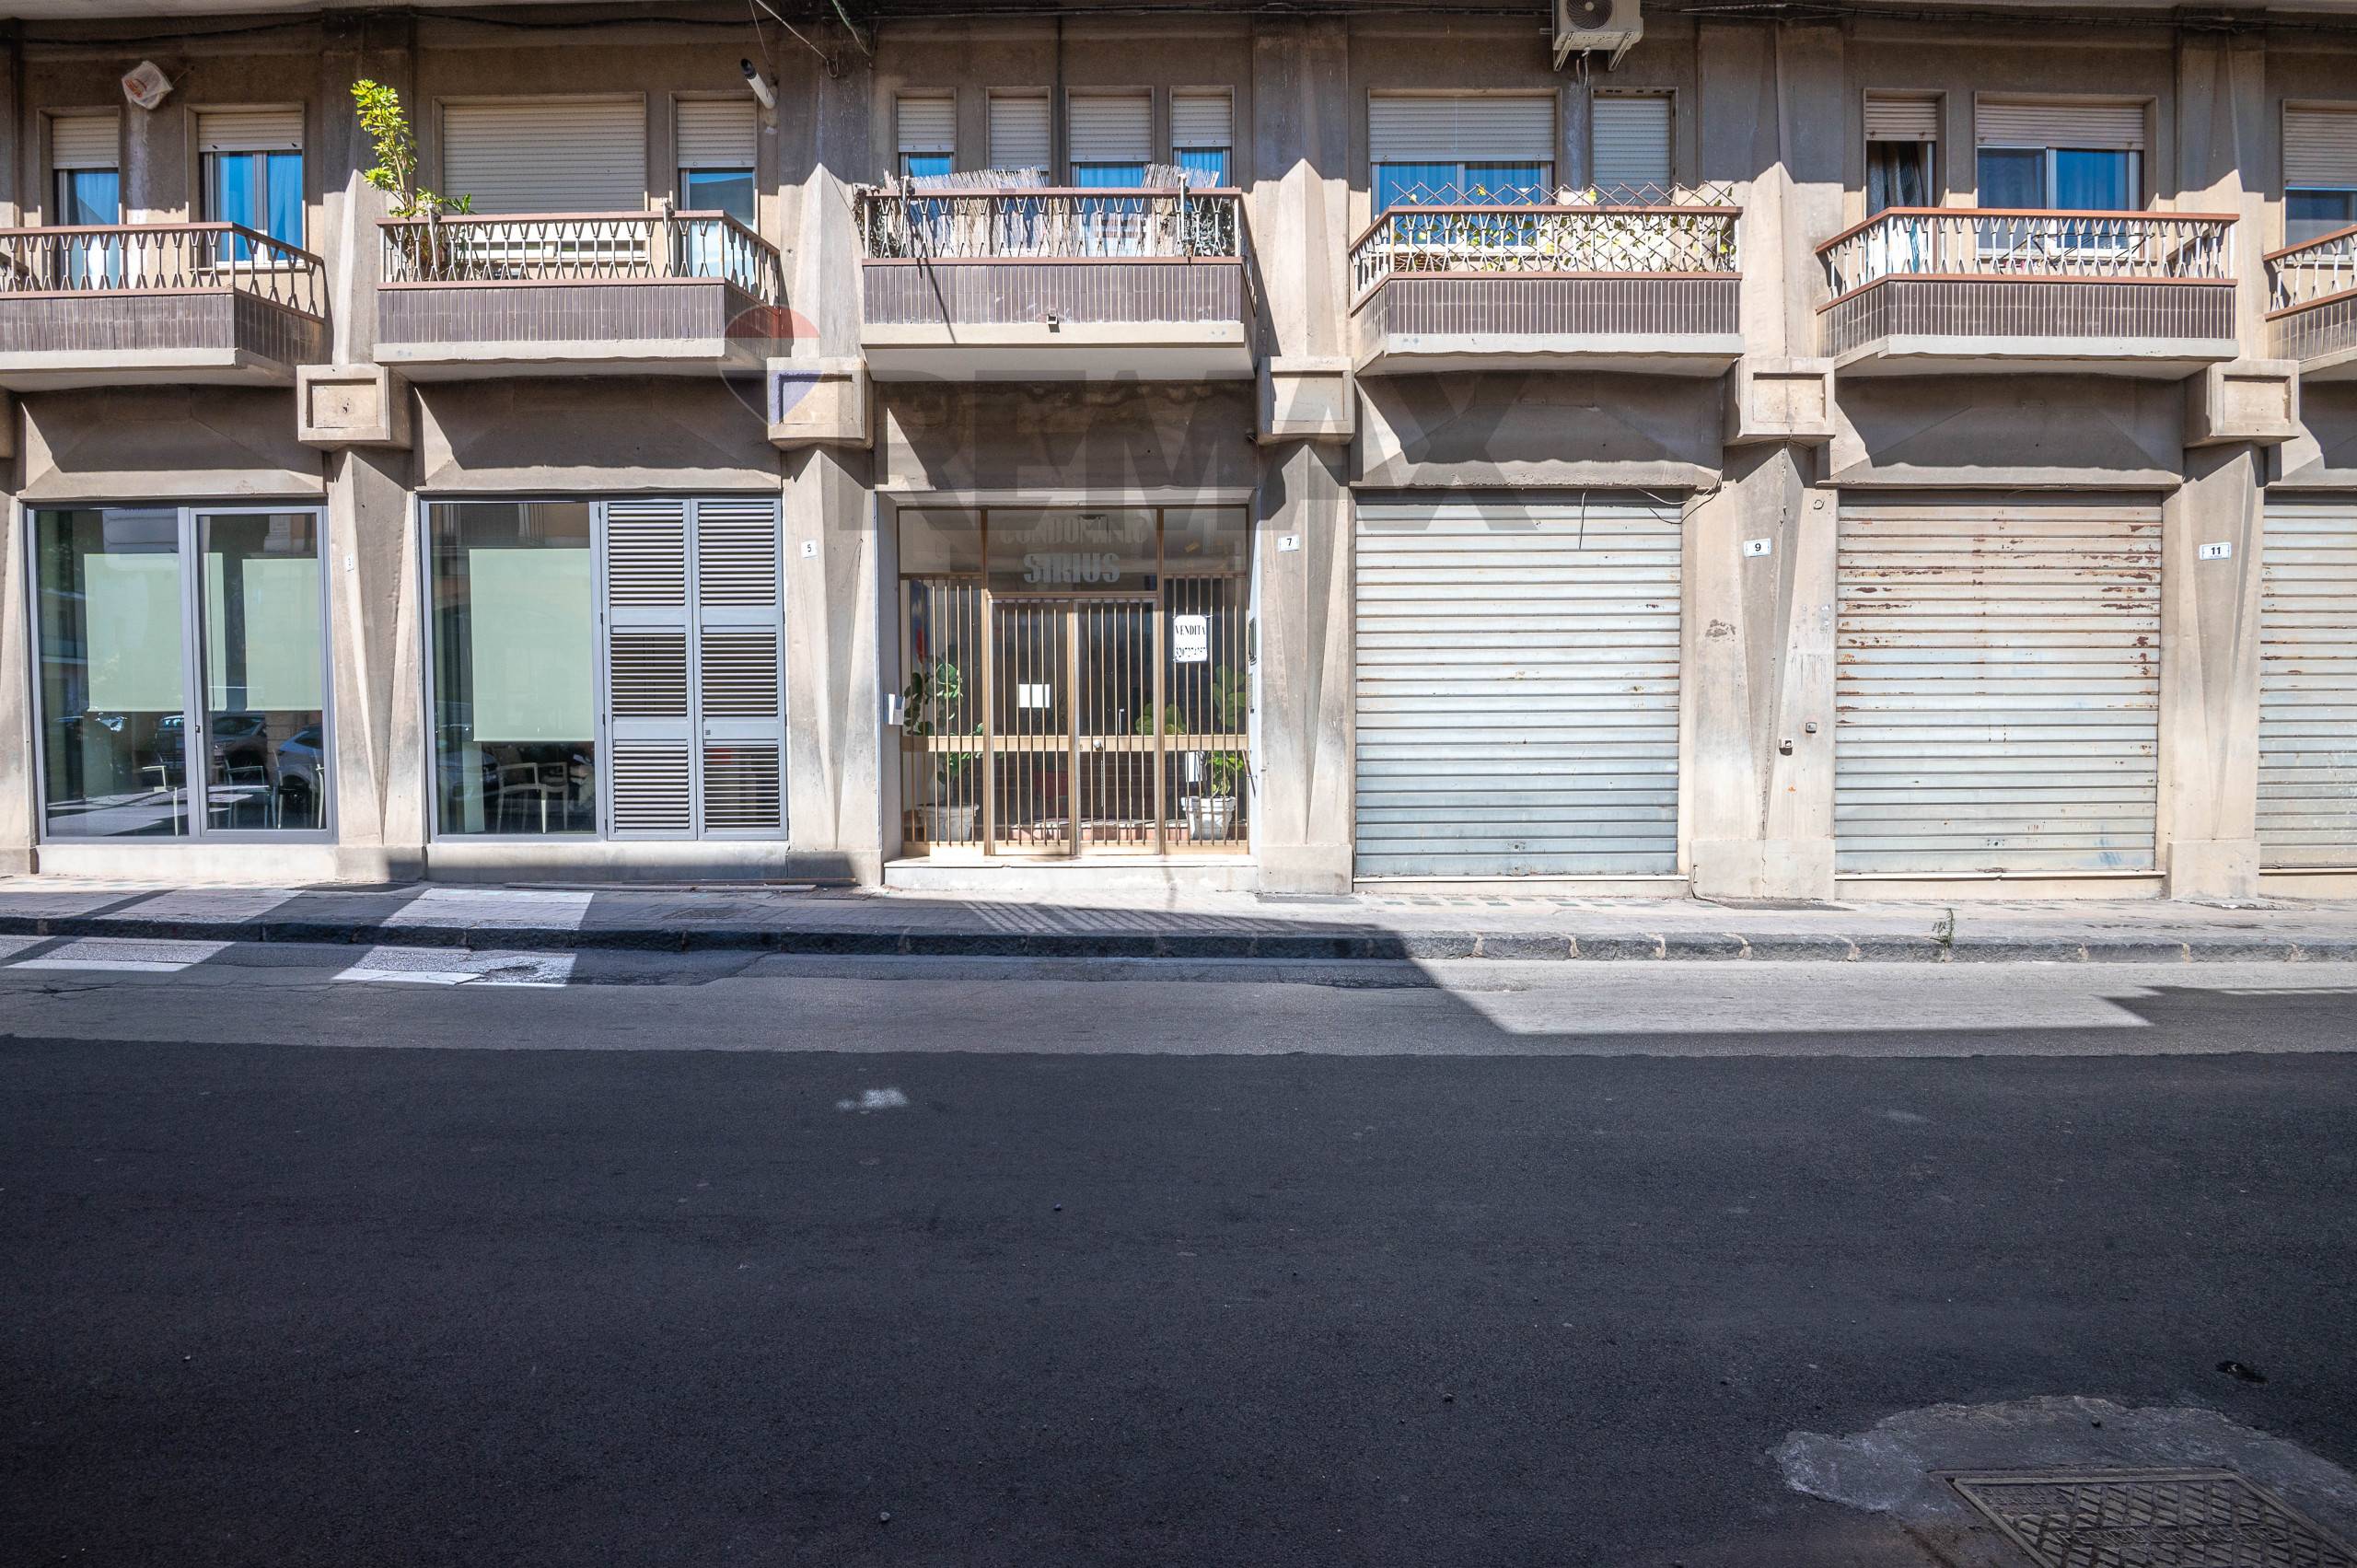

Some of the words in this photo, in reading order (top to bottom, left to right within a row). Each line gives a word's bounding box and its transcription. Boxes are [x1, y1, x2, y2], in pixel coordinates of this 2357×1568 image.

[1286, 538, 1292, 546] 7
[807, 543, 812, 552] 5
[1755, 542, 1761, 552] 9
[2211, 546, 2221, 555] 11
[1023, 552, 1120, 584] SIRIUS
[1175, 624, 1206, 635] VENDITA
